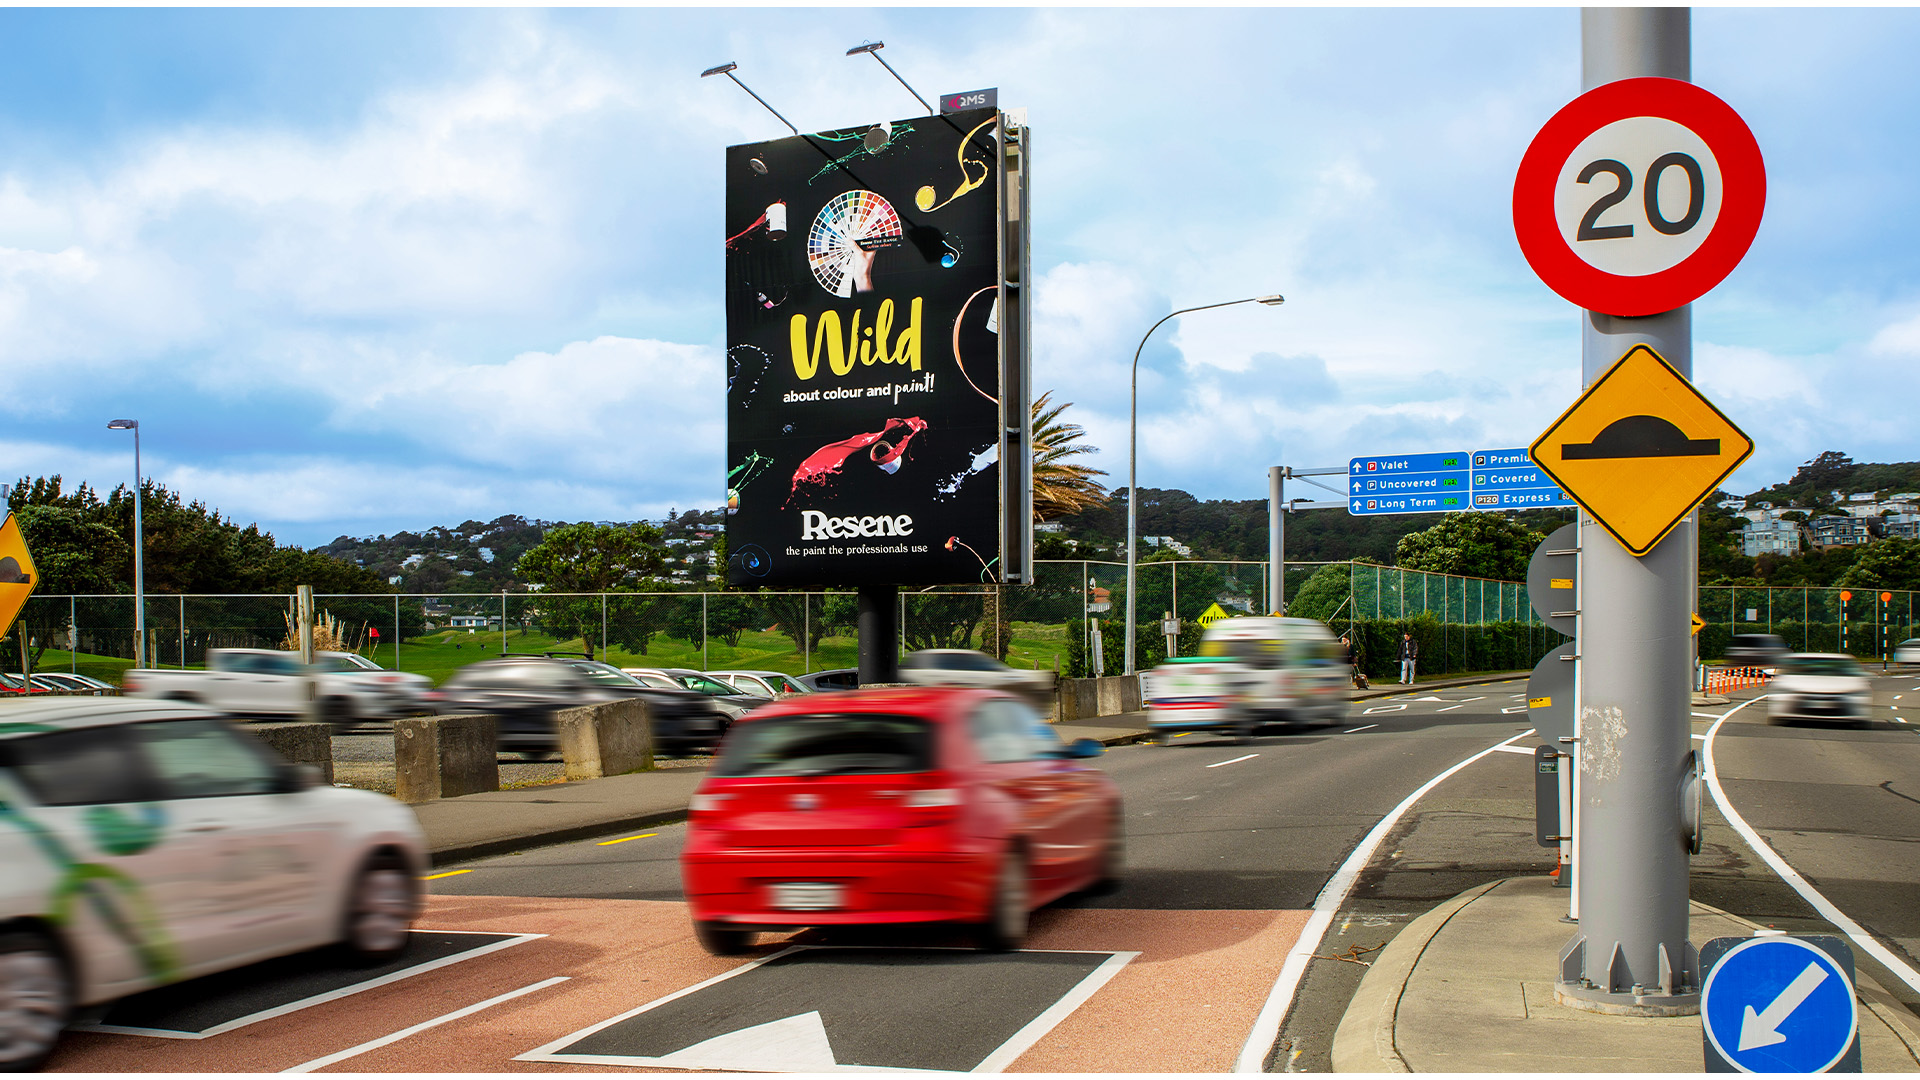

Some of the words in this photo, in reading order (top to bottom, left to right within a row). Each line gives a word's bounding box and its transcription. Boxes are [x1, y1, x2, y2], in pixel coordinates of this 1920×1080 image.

[953, 94, 986, 109] QMS
[1576, 151, 1705, 242] 20
[790, 296, 923, 381] Wild
[783, 390, 820, 403] about
[823, 387, 863, 400] colour
[866, 383, 891, 397] and
[894, 372, 935, 405] paint!
[1380, 460, 1409, 470] Valet
[1490, 454, 1532, 464] Premiu
[1380, 478, 1437, 489] Uncovered
[1490, 473, 1536, 484] Covered
[1380, 500, 1406, 509] Long
[1410, 498, 1437, 507] Term
[1477, 496, 1498, 504] P120
[1503, 494, 1551, 504] Express
[801, 510, 914, 541] Resene
[785, 546, 800, 556] the
[803, 545, 826, 557] paint
[829, 545, 843, 555] the
[846, 543, 908, 556] professionals
[911, 544, 928, 553] use
